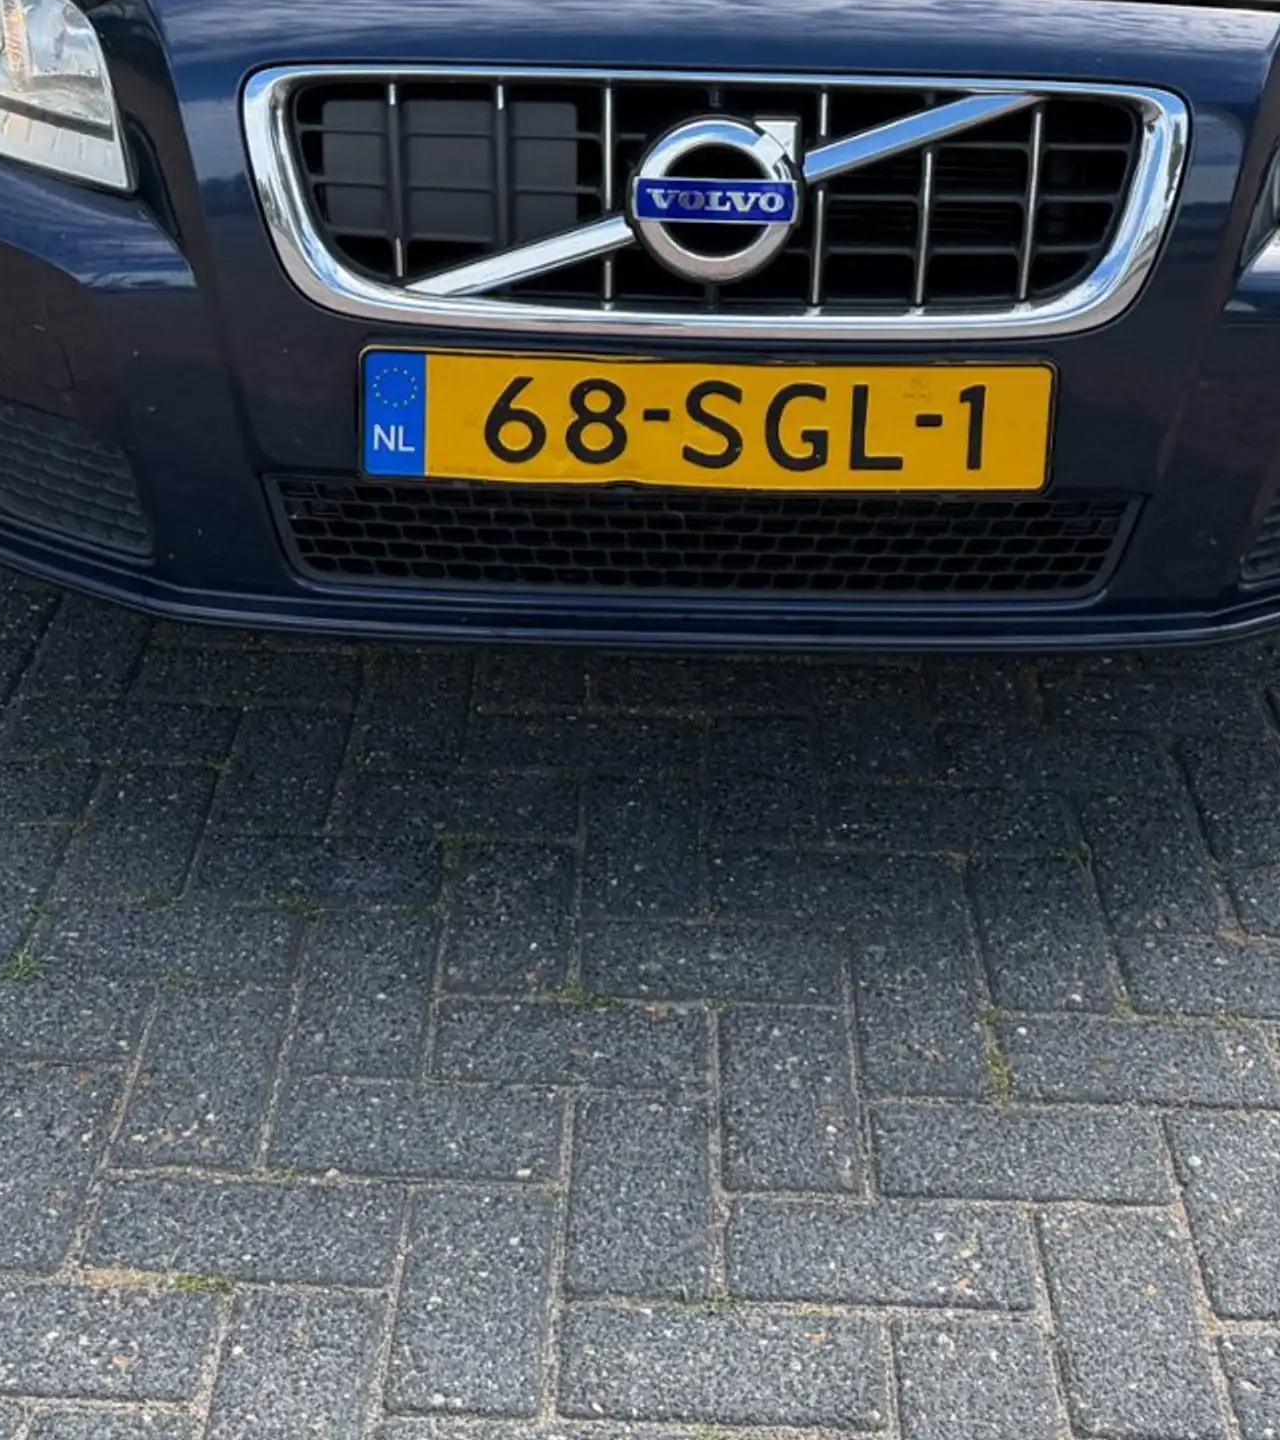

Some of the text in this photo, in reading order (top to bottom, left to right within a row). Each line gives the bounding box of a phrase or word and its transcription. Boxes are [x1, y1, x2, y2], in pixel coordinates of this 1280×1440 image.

[646, 188, 786, 214] VOLVO
[372, 375, 987, 473] NL 68-SGL-1
